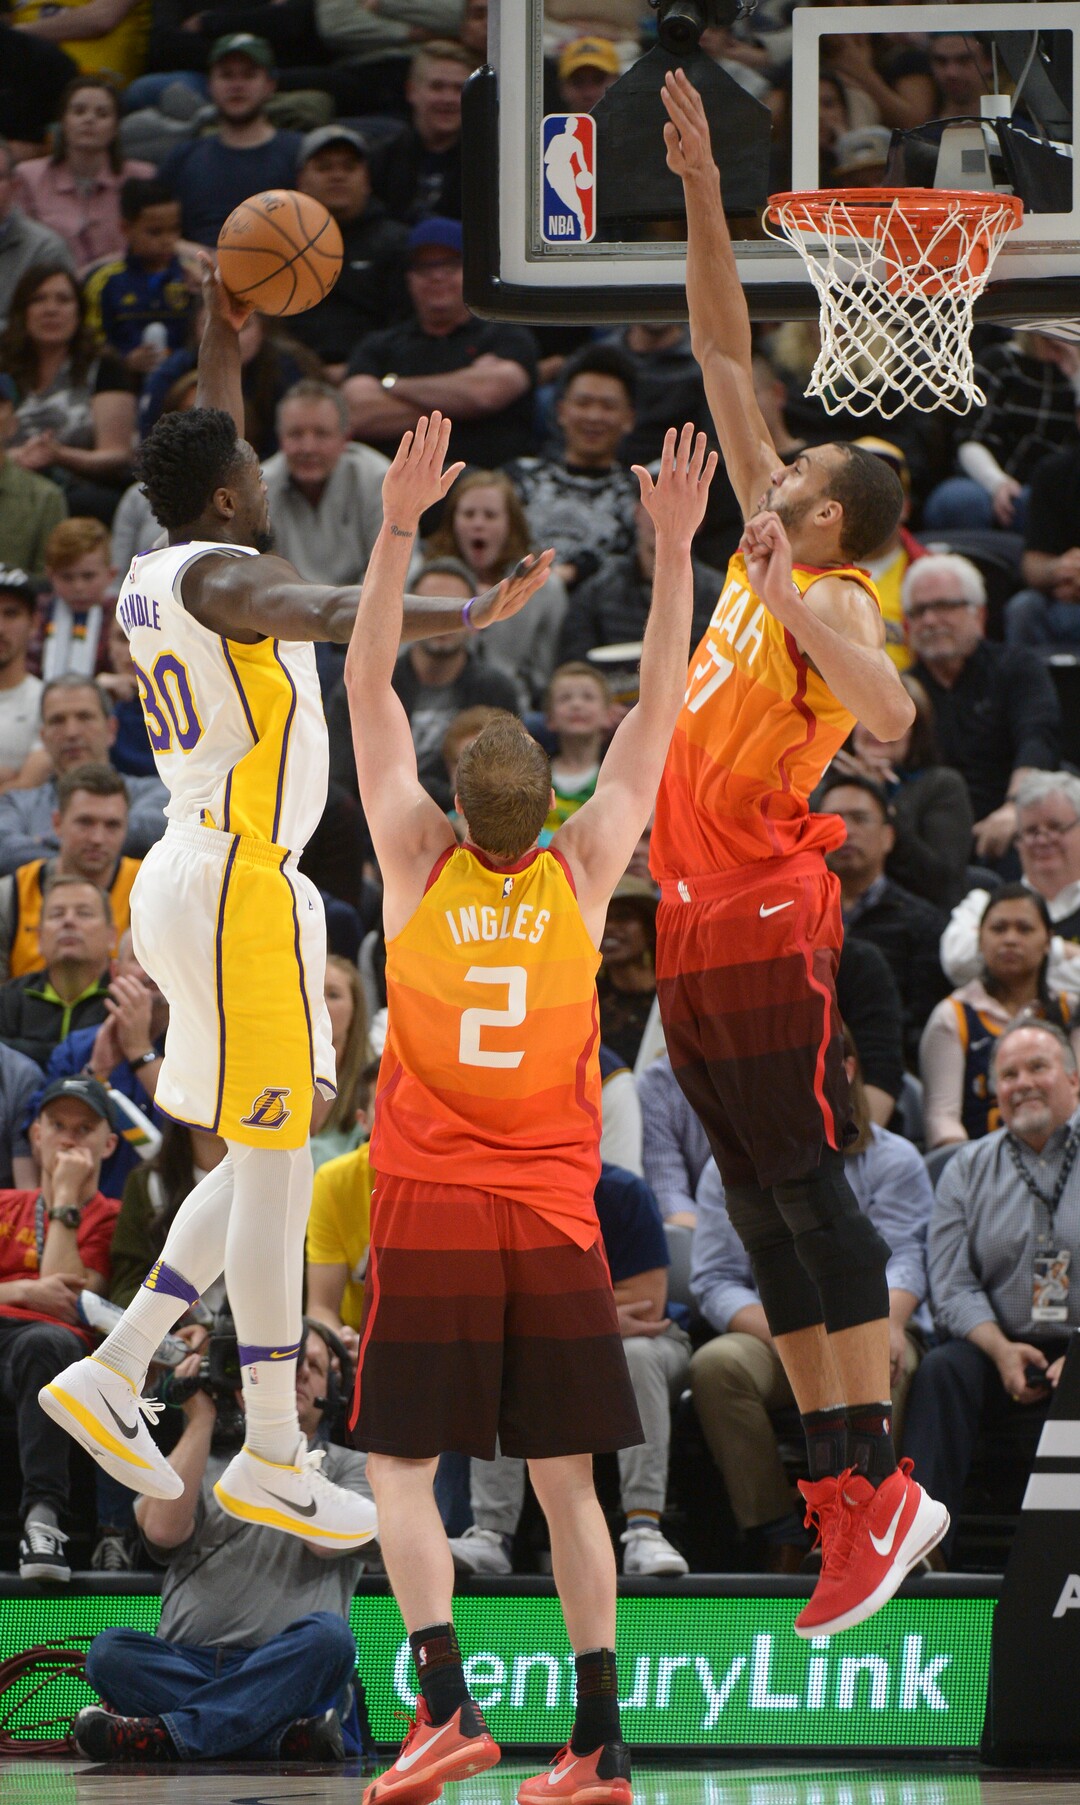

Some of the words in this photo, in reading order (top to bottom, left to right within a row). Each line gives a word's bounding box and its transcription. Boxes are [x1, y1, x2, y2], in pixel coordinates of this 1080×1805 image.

[548, 215, 575, 236] NBA
[131, 650, 206, 755] 30
[445, 903, 551, 946] INGLES
[458, 965, 528, 1069] 2
